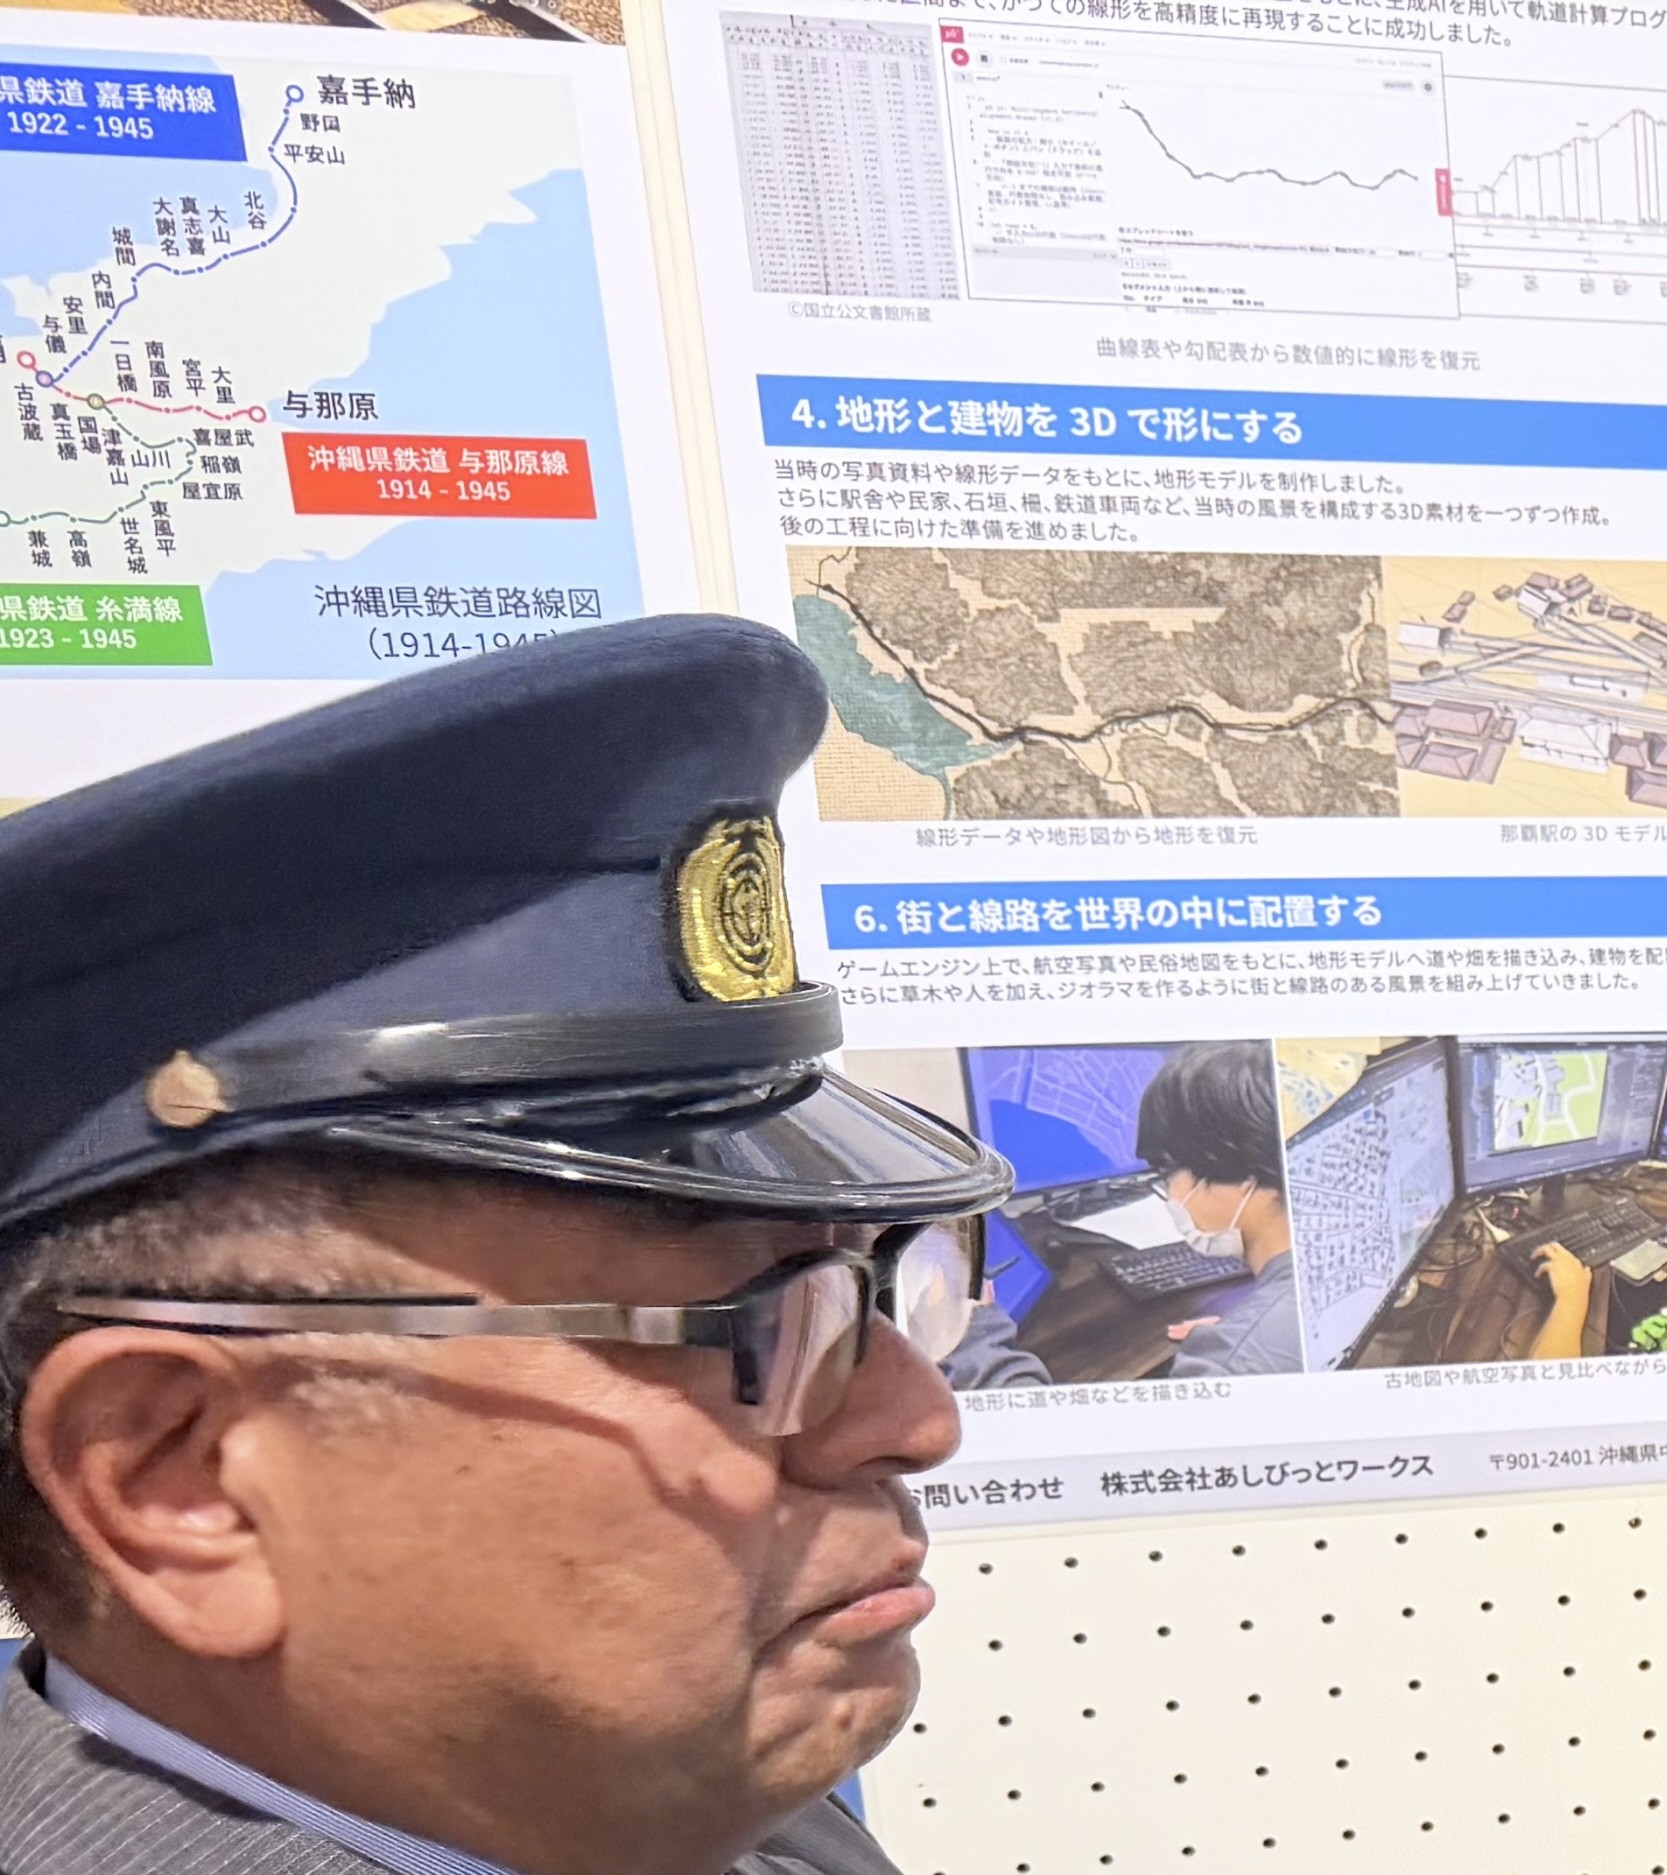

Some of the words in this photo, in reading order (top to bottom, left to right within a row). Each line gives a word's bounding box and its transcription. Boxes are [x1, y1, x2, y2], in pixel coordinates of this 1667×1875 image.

[95, 81, 217, 113] 嘉手納線
[317, 74, 416, 109] 嘉手納
[7, 111, 69, 136] 1922
[94, 115, 155, 139] 1945
[284, 143, 345, 165] 平安山
[207, 205, 232, 245] 大山
[243, 190, 268, 230] 北谷
[112, 227, 137, 266] 城間
[91, 271, 116, 310] 内間
[62, 296, 88, 335] 安里
[110, 339, 138, 392] 一日橋
[145, 340, 173, 399] 南風原
[1096, 337, 1481, 373] 曲線表や勾配表から数値的に線形を復元
[182, 358, 206, 397] 宮平
[211, 366, 236, 404] 大里
[14, 383, 44, 442] 古波蔵
[282, 390, 379, 420] 与那原
[791, 398, 826, 431] 4.
[837, 396, 1058, 438] 地形と建物を
[1070, 406, 1117, 438] 3D
[1127, 406, 1304, 446] で形にする
[50, 402, 78, 461] 真玉橋
[77, 415, 102, 455] 国場
[192, 428, 255, 447] 喜屋武
[130, 450, 171, 469] 山川
[307, 445, 450, 473] 沖縄県鉄道
[459, 449, 570, 476] 与那原線
[377, 479, 432, 500] 1914
[457, 481, 512, 502] 1945
[120, 517, 149, 575] 世名城
[150, 500, 176, 557] 東風平
[780, 515, 1140, 544] 後の工程に向けた準備を進めました。
[67, 530, 92, 568] 高嶺
[96, 596, 184, 623] 糸満線
[314, 584, 602, 620] 沖縄県鉄道路線図
[79, 629, 137, 649] 1945
[916, 825, 1259, 848] 線形データや地形図から地形を復元
[1583, 825, 1608, 843] 3D
[854, 904, 887, 934] 6.
[897, 894, 1383, 936] 街と線路を世界の中に配置する
[1100, 1452, 1434, 1497] 株式会社あしびっとワークス
